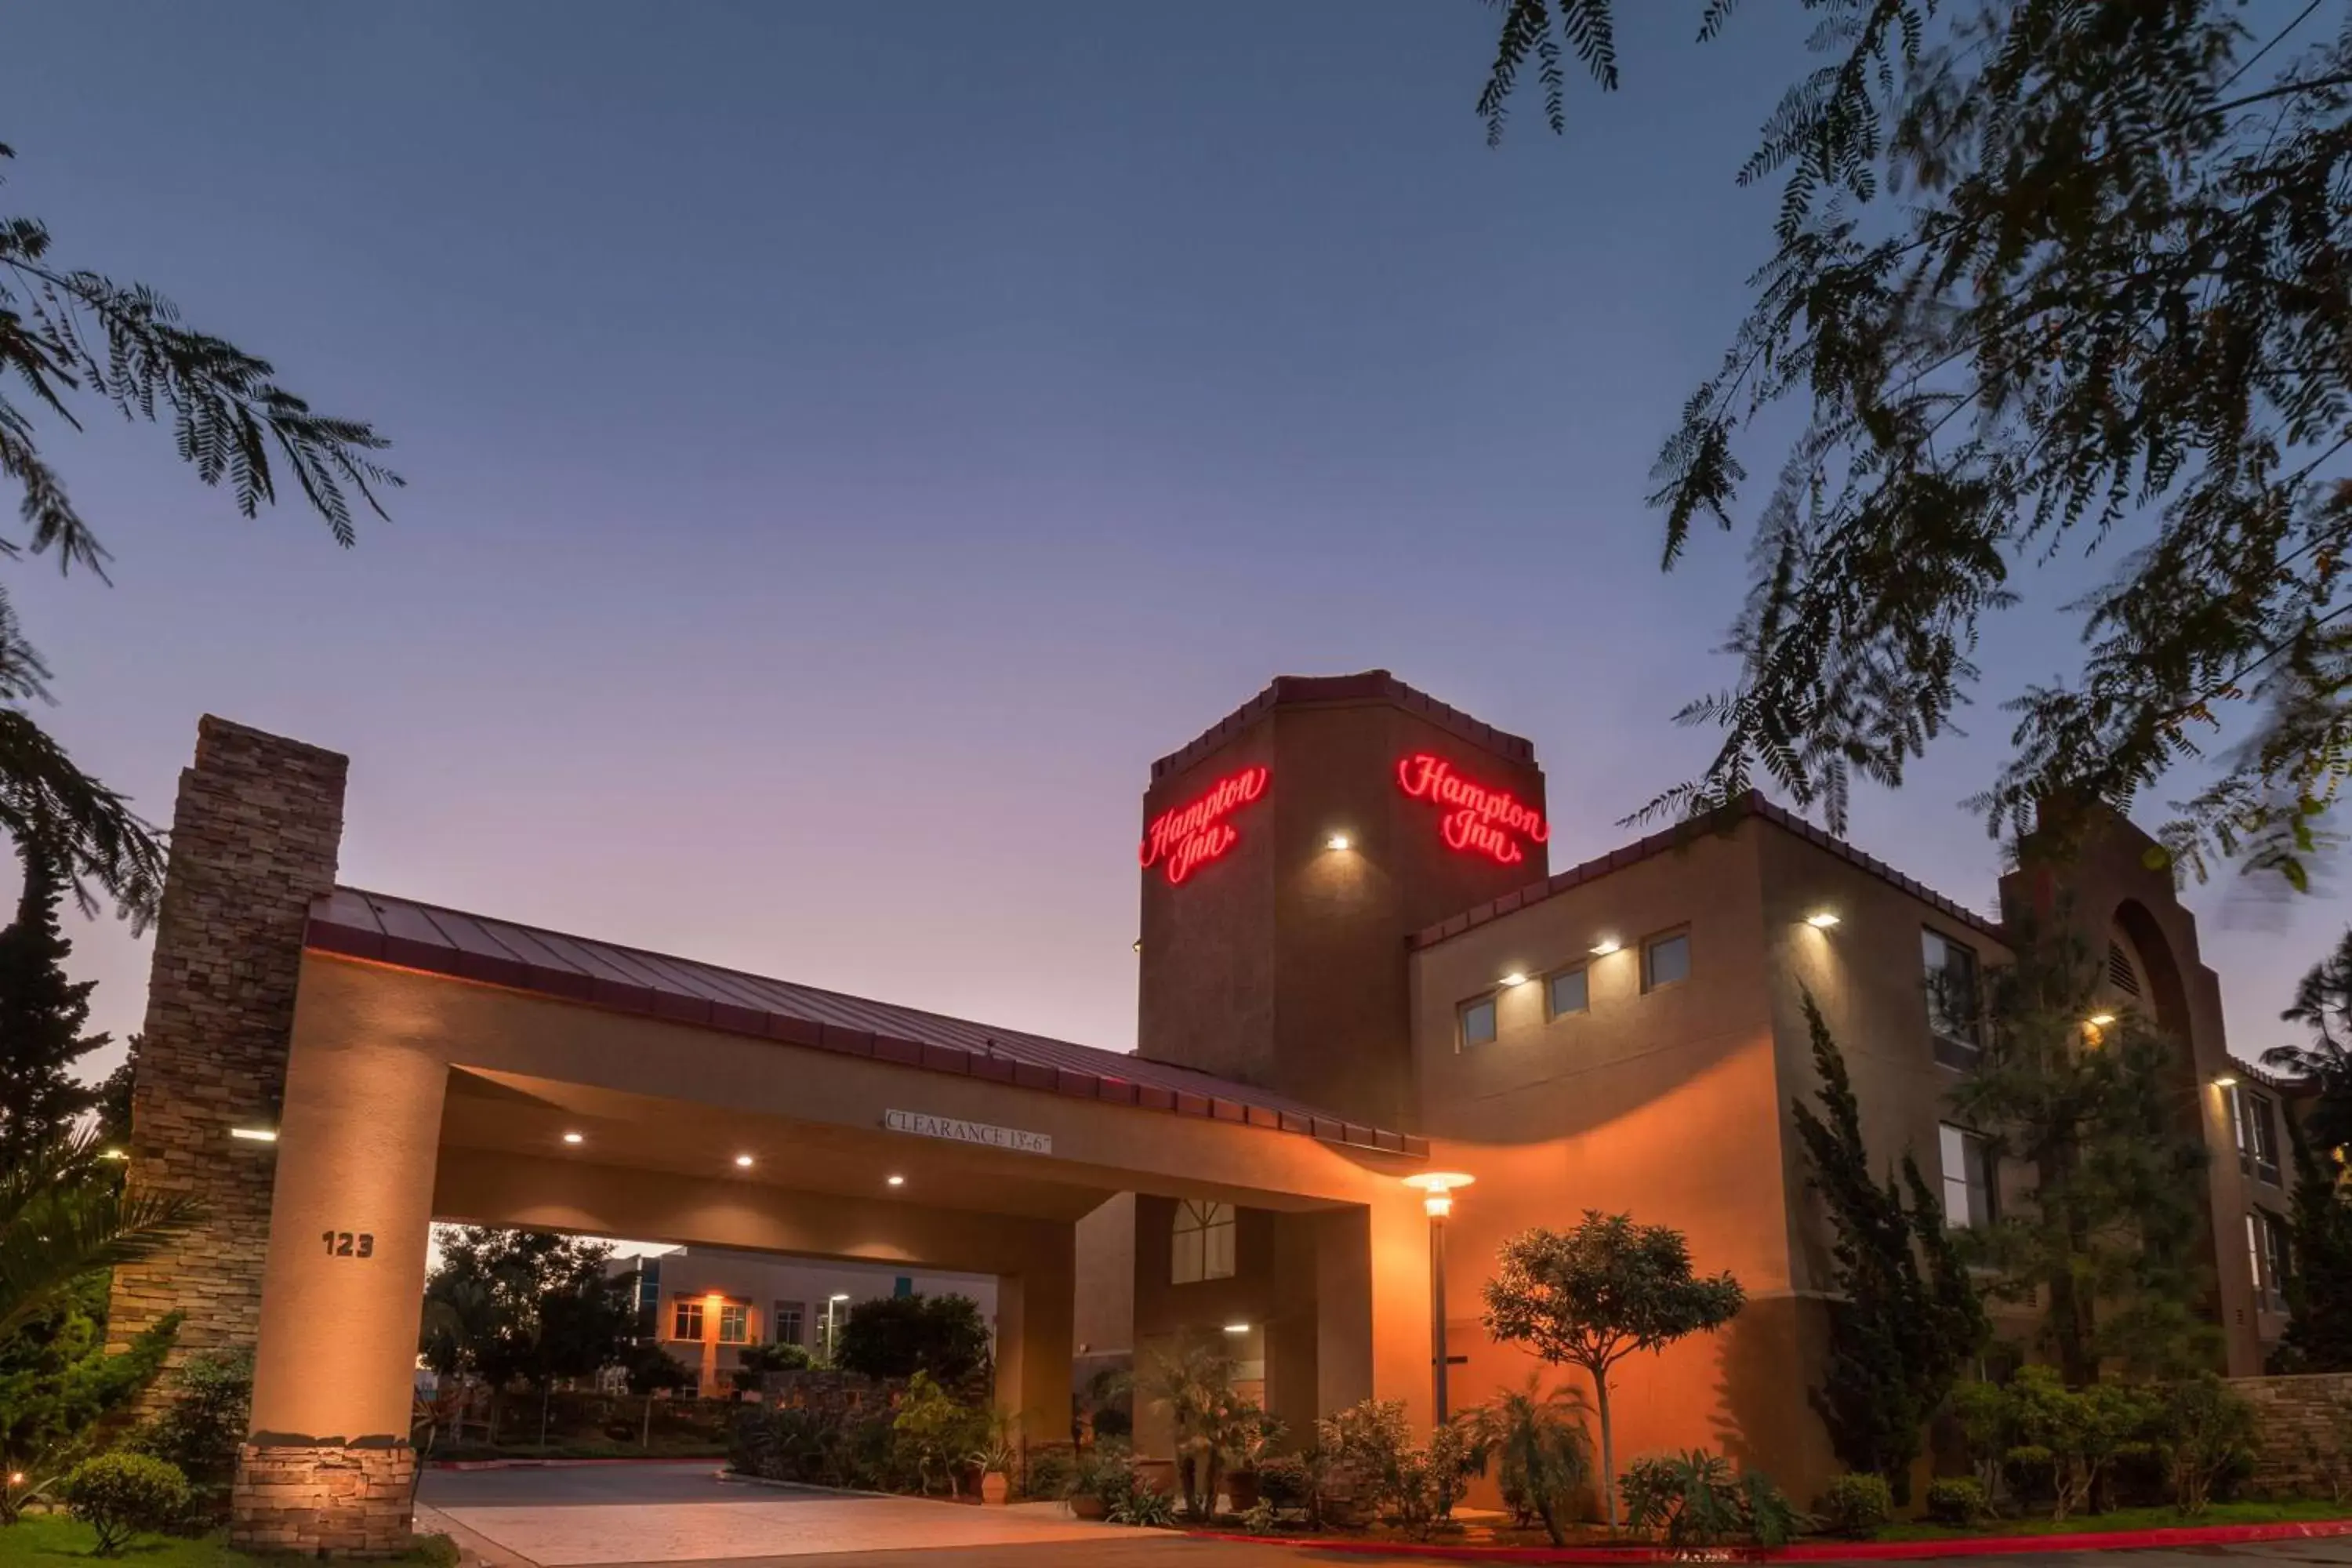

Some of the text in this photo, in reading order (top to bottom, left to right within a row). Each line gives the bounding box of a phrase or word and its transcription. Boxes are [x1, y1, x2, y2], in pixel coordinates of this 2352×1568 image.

[1139, 768, 1266, 868] Hampton
[1399, 754, 1552, 843] Hampton
[1169, 825, 1235, 883] Inn
[1443, 808, 1522, 862] Inn
[886, 1110, 1004, 1145] CLEARANCE
[321, 1230, 374, 1258] 123
